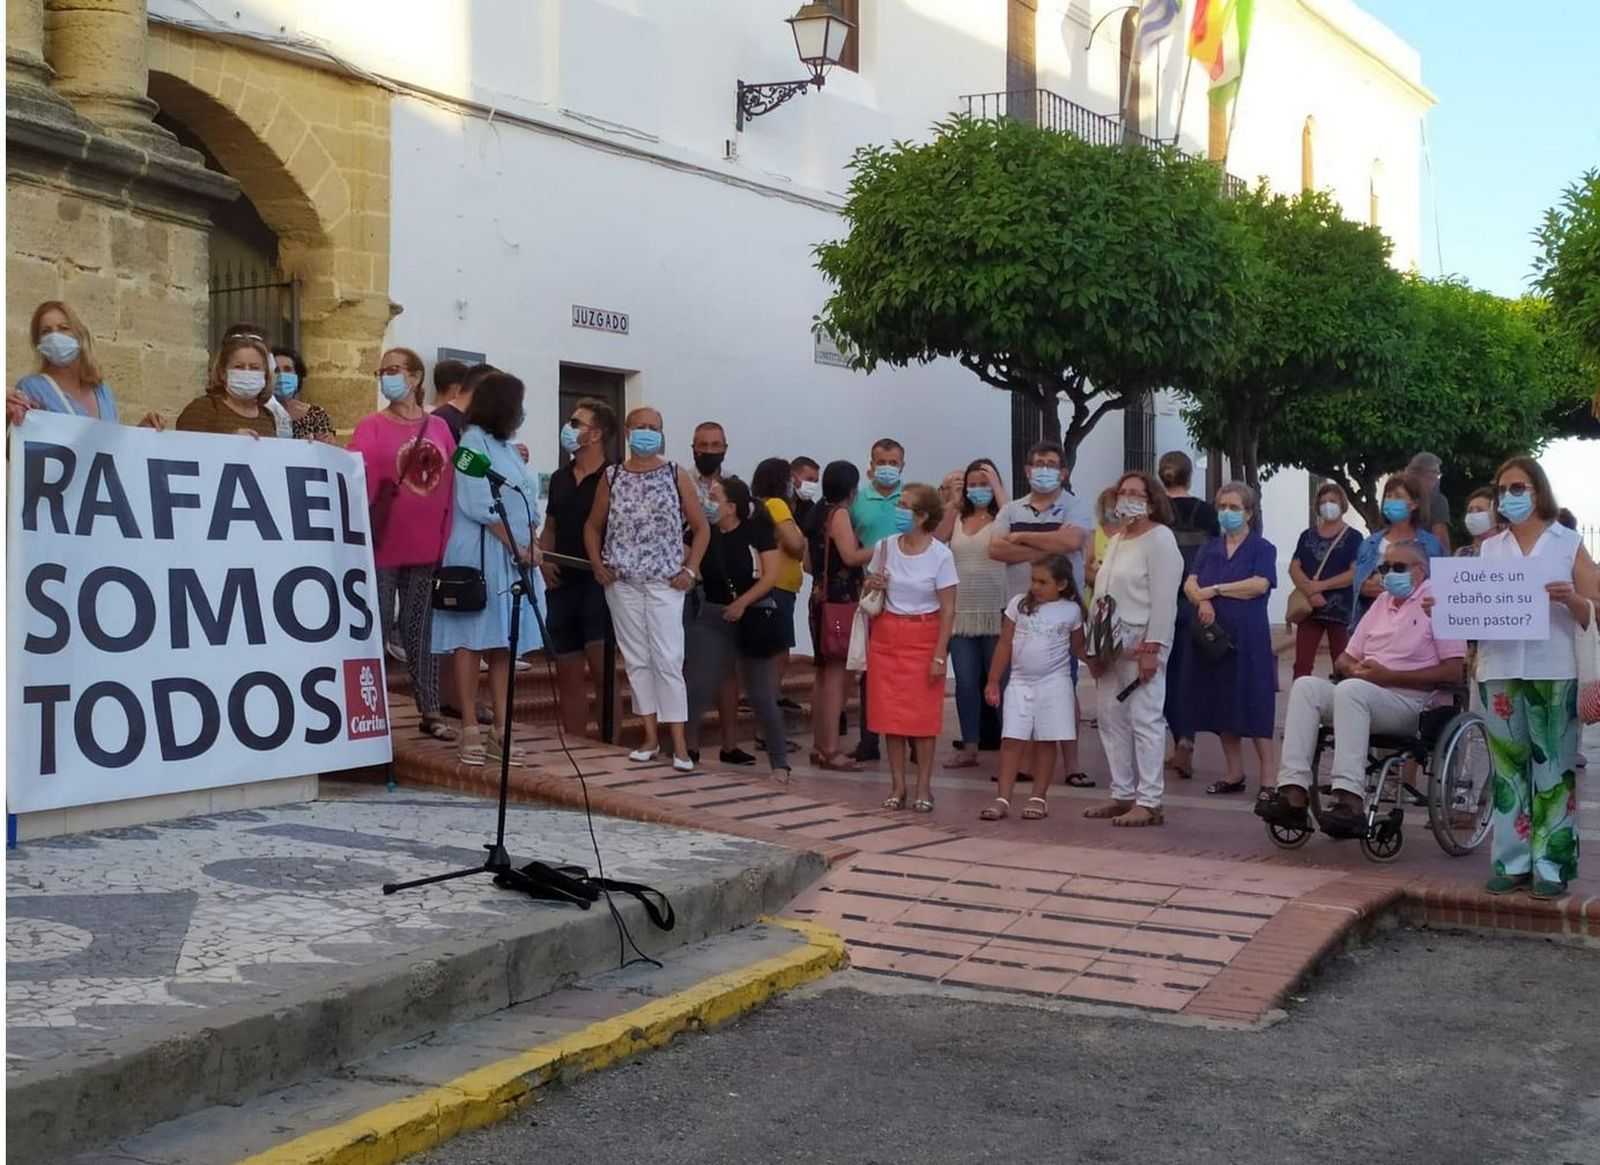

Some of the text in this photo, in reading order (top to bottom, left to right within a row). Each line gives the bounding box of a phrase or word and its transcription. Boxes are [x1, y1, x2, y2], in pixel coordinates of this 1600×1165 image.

[574, 309, 627, 330] JUZGADO
[22, 440, 366, 546] RAFAEL
[1453, 569, 1525, 583] ¿Qué es un
[1447, 592, 1532, 604] rebaño sin su
[23, 563, 374, 655] SOMOS
[1448, 613, 1532, 628] buen pastor?
[23, 666, 342, 776] TODOS
